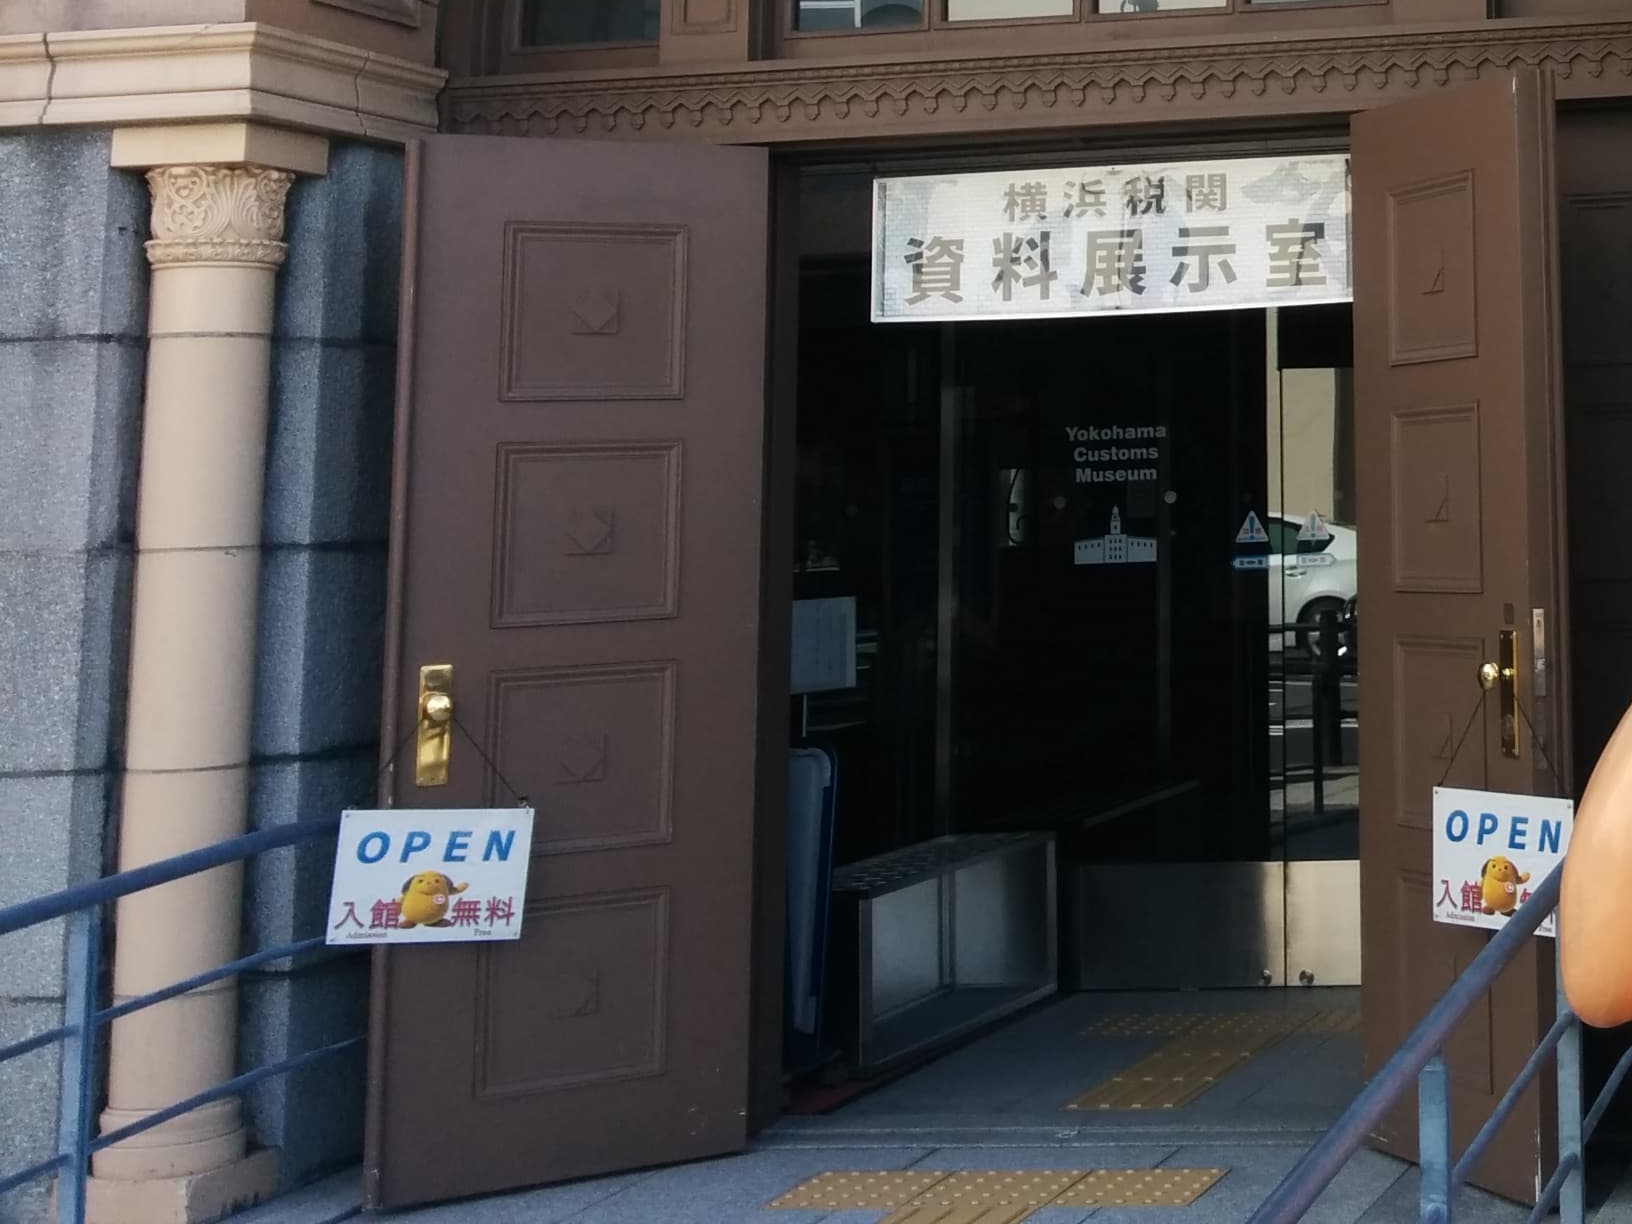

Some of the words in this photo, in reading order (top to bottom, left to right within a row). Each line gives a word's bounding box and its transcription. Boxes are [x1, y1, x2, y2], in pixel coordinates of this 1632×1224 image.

[1002, 173, 1229, 222] 横浜税関
[904, 218, 1328, 306] 資料展示室
[1065, 425, 1167, 443] Yokohama
[1073, 445, 1160, 463] Customs
[1075, 466, 1158, 484] Museum
[355, 829, 517, 864] OPEN
[1445, 809, 1562, 854] OPEN
